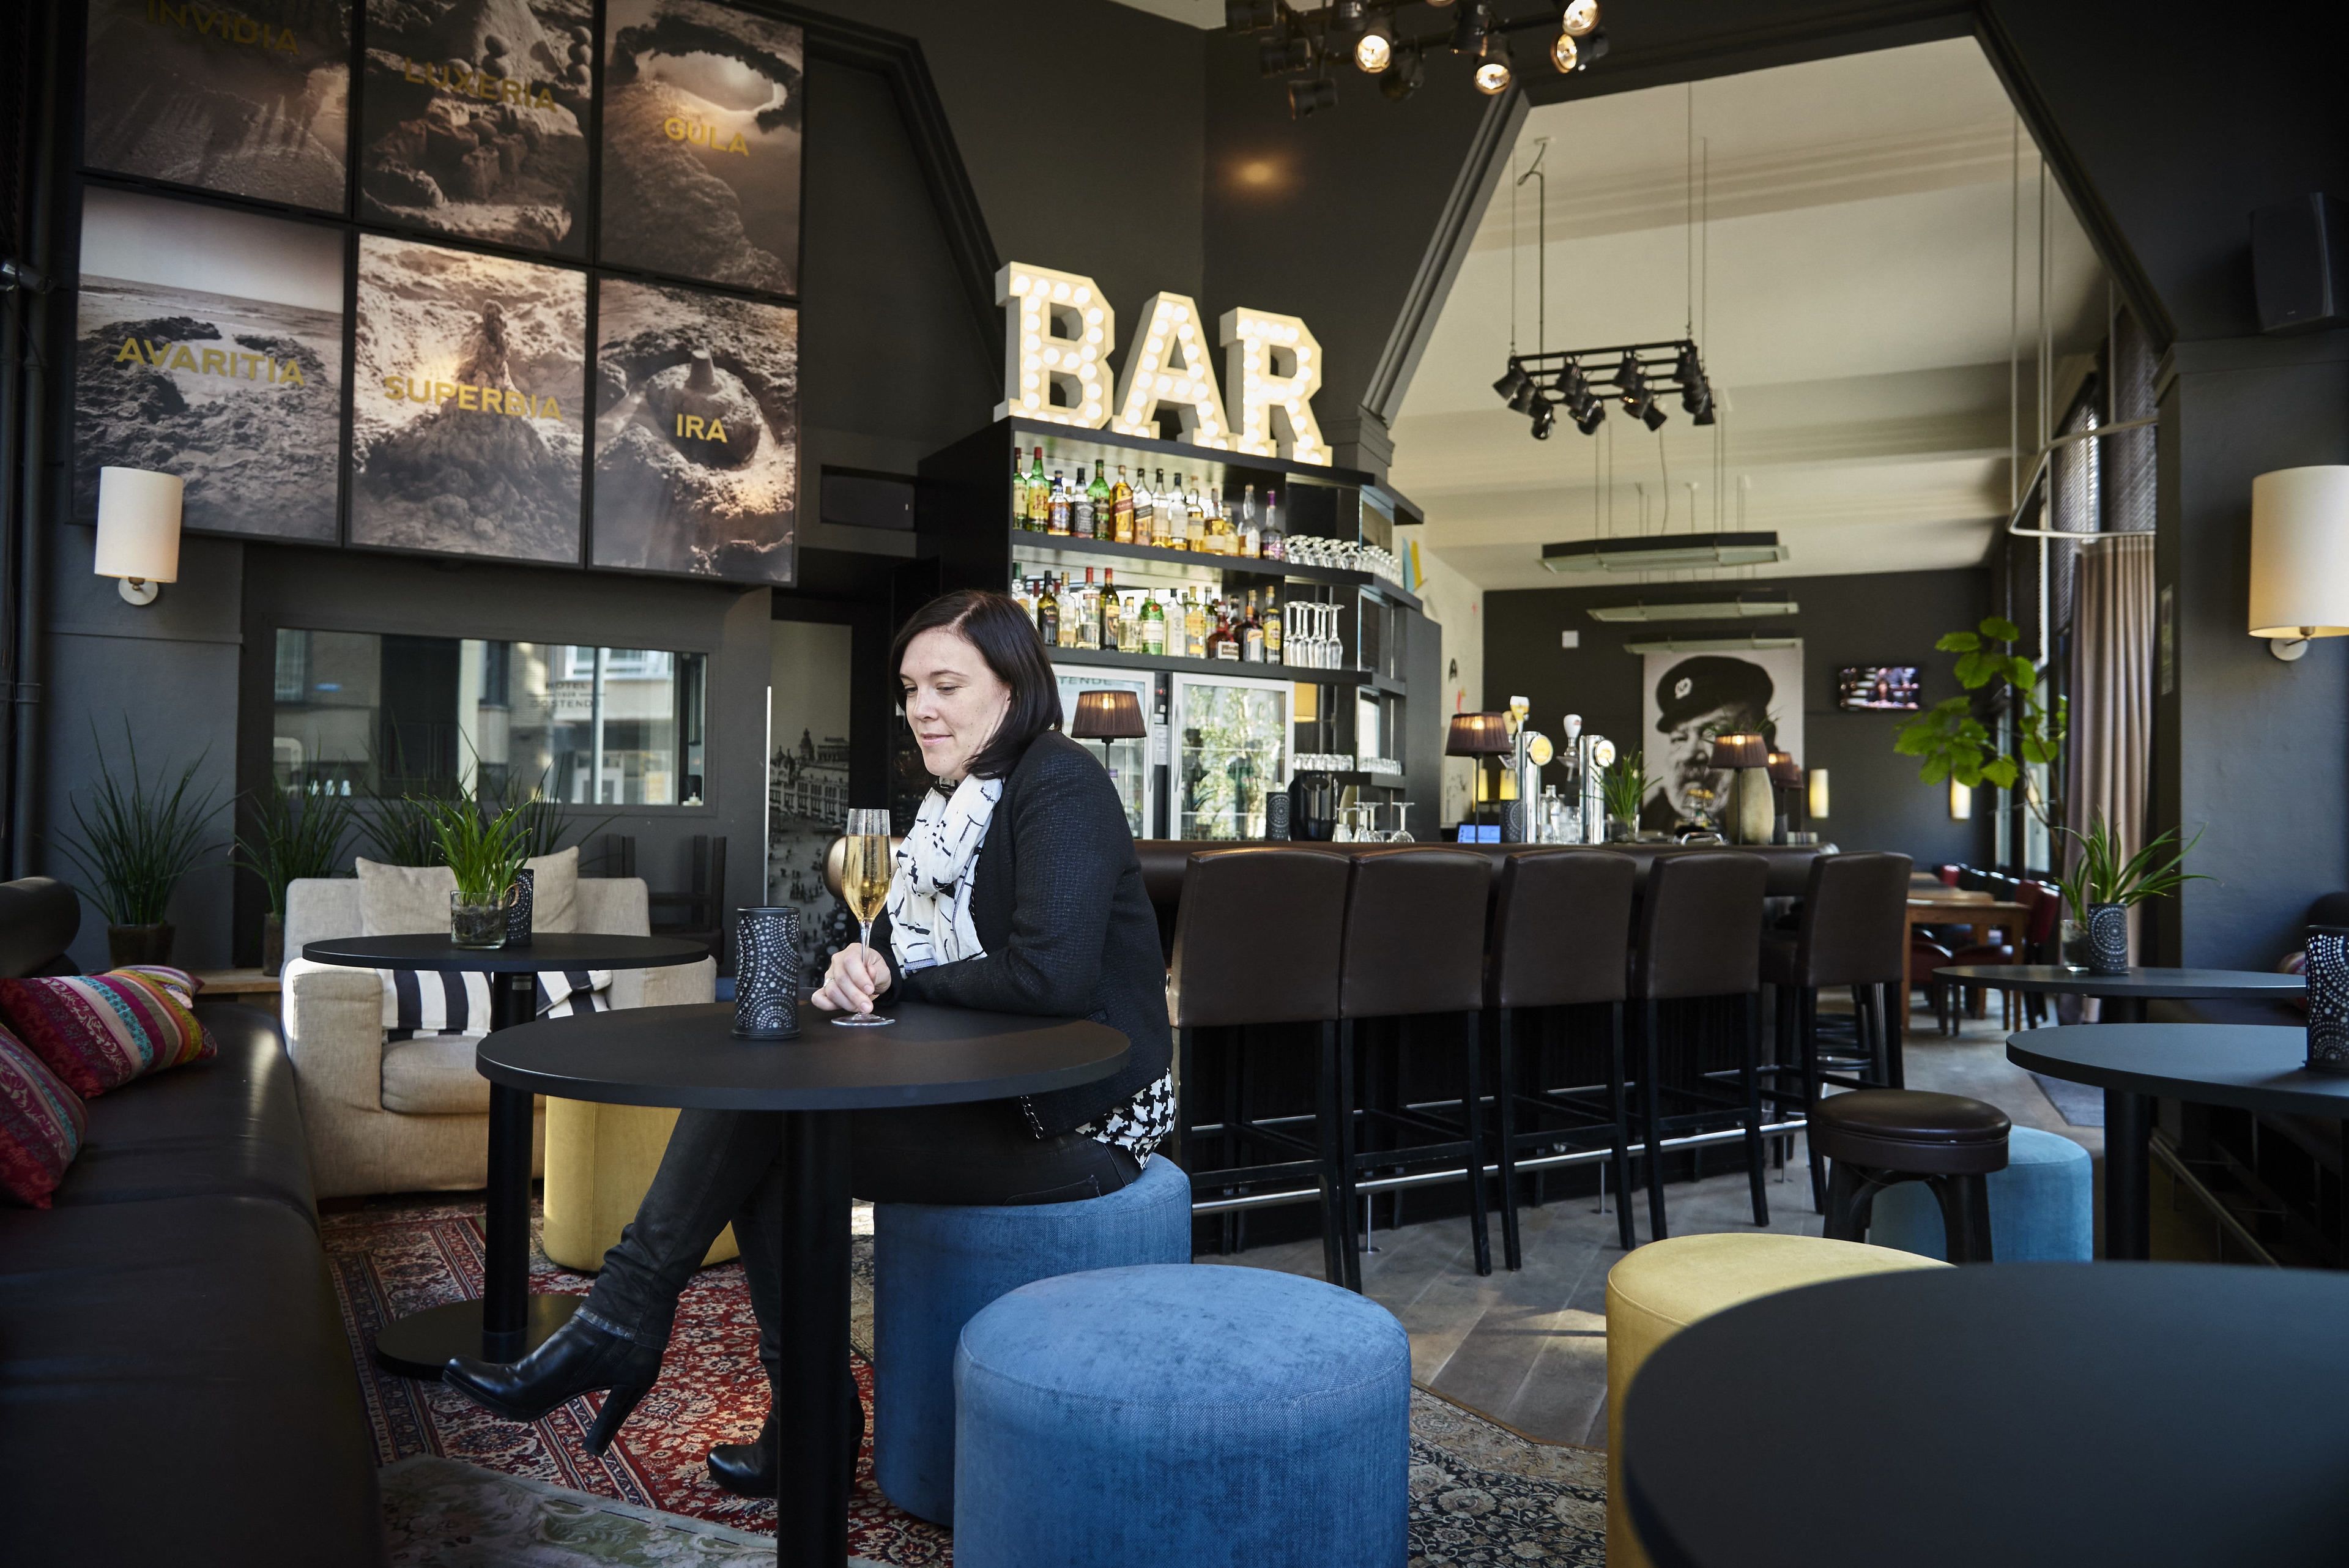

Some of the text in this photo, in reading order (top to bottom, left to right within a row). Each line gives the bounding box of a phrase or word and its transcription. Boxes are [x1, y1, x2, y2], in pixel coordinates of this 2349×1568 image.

[146, 0, 300, 55] INVIDIA
[404, 57, 558, 113] LUXERIA
[664, 116, 750, 157] GULA
[116, 337, 305, 387] AVARITIA
[993, 261, 1332, 467] BAR
[384, 375, 563, 422] SUPERBIA
[677, 413, 728, 443] IRA
